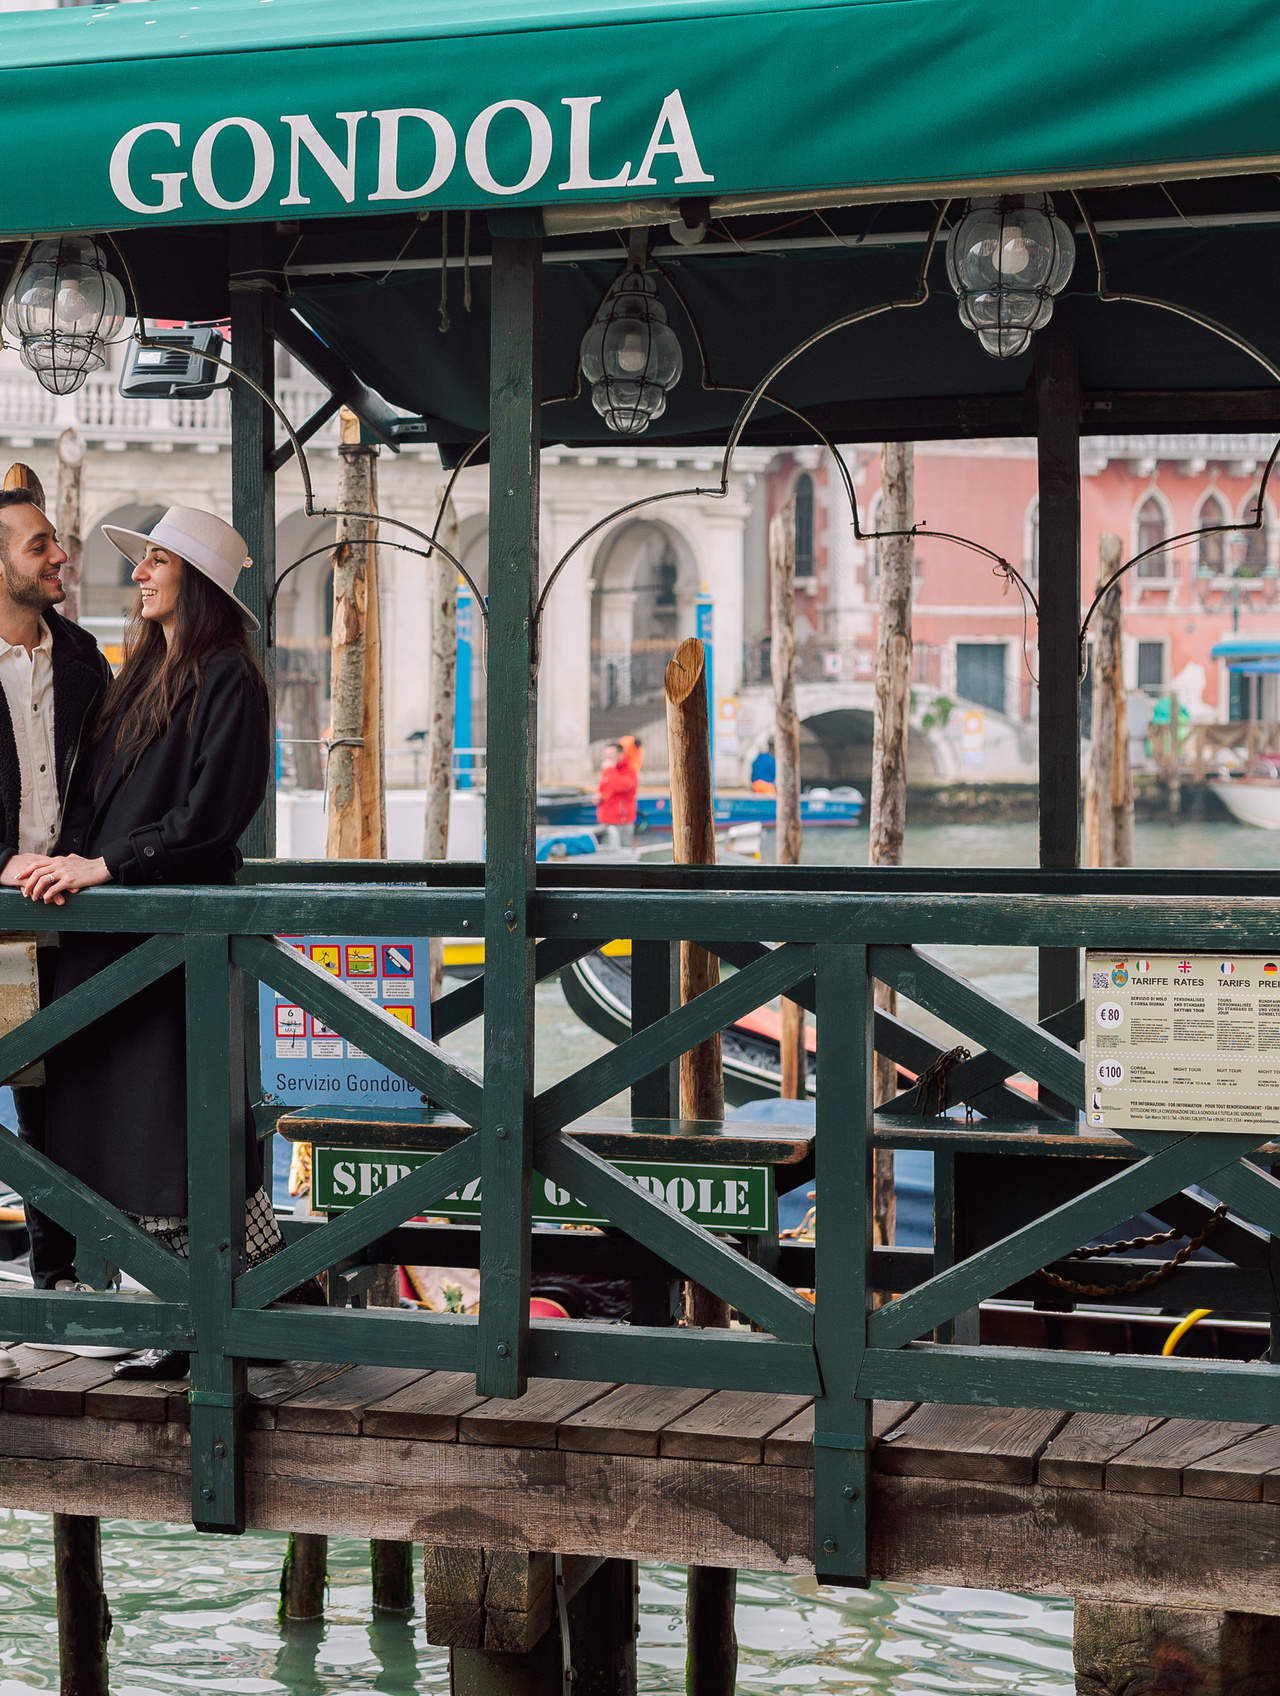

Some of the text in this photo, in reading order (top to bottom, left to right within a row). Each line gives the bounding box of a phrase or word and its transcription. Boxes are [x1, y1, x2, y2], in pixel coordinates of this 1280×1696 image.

[109, 89, 714, 214] GONDOLA
[1131, 978, 1168, 986] TARIFFE
[1174, 978, 1204, 986] RATES
[1218, 979, 1250, 988] TARIFS
[288, 1009, 294, 1017] 6
[1099, 1066, 1121, 1078] €100
[276, 1073, 341, 1091] Servizio
